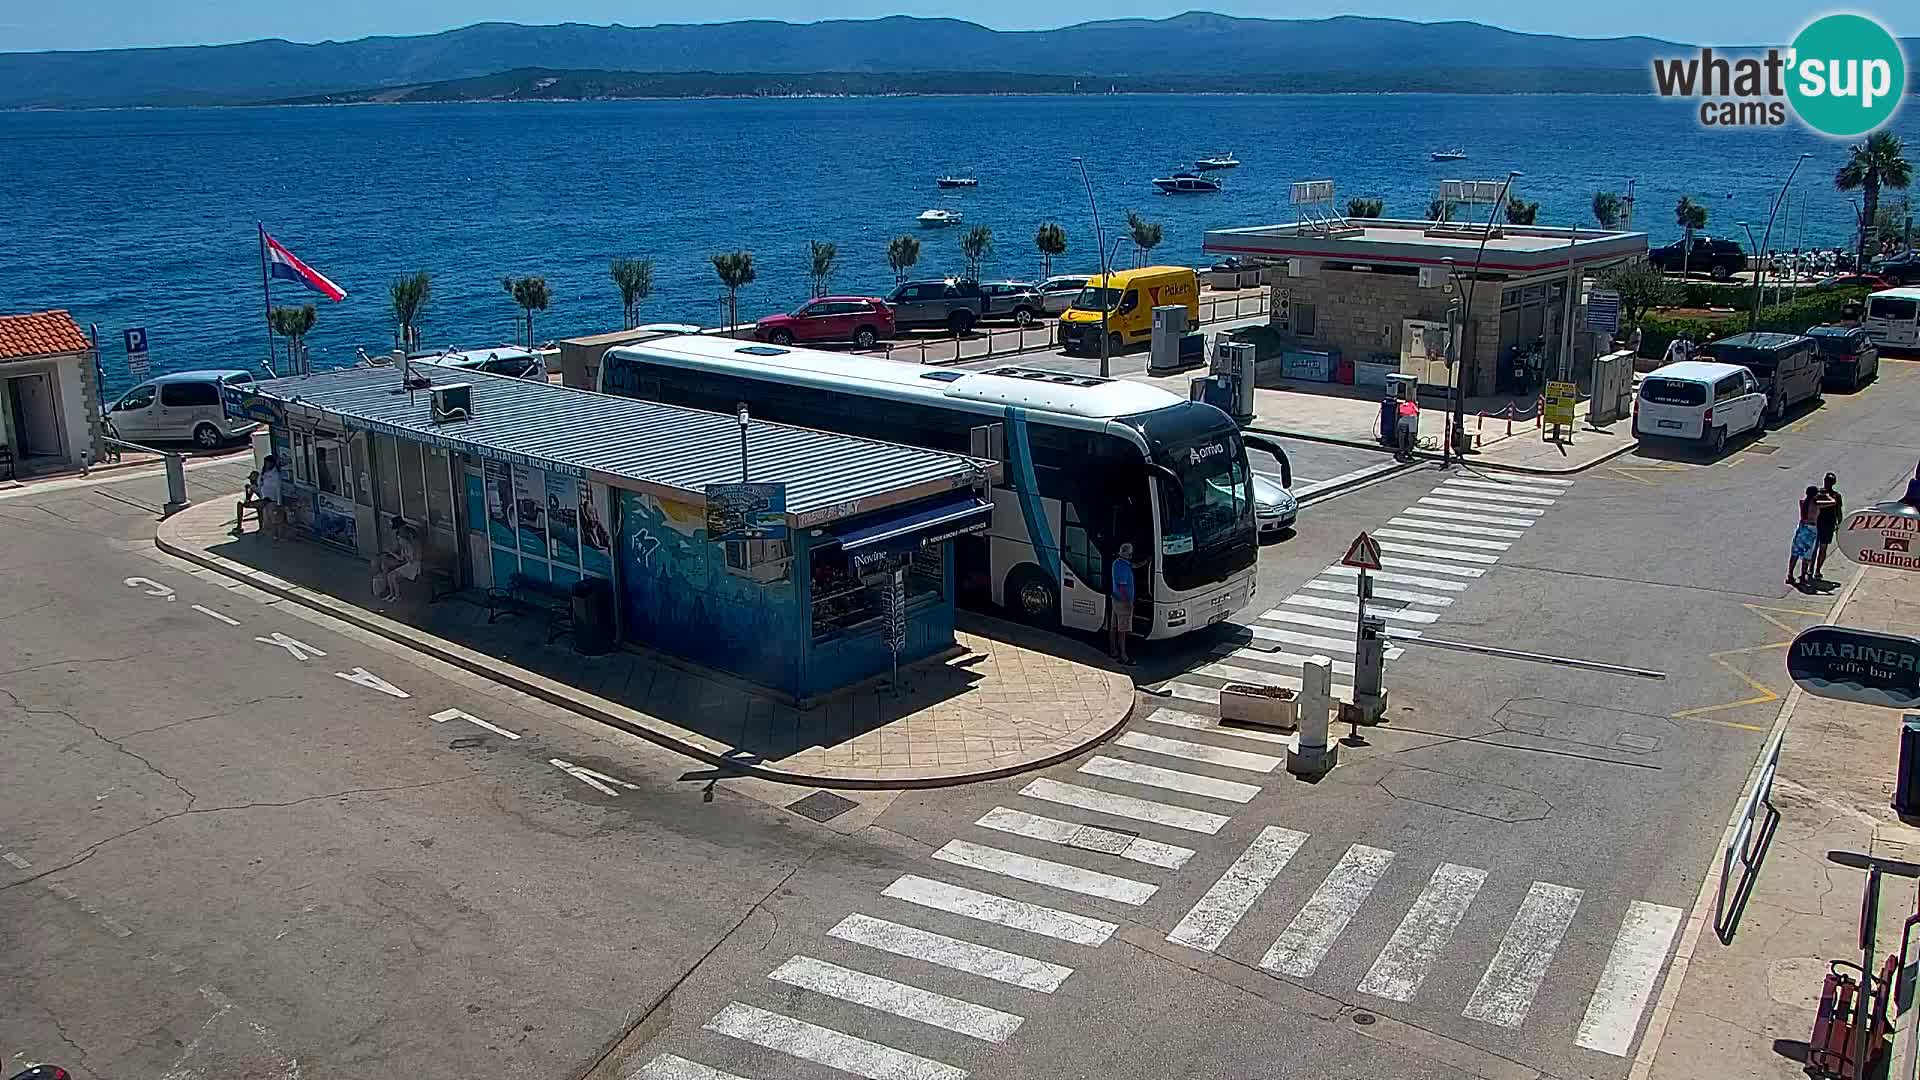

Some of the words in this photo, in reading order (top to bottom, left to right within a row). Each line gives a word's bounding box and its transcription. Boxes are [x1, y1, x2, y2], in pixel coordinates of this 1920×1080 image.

[1199, 443, 1224, 458] arriva
[477, 446, 493, 458] BUS
[494, 449, 526, 465] STATION
[528, 456, 553, 471] TICKET
[554, 462, 582, 476] OFFICE
[1828, 661, 1864, 673] caffe
[1870, 665, 1896, 680] bar
